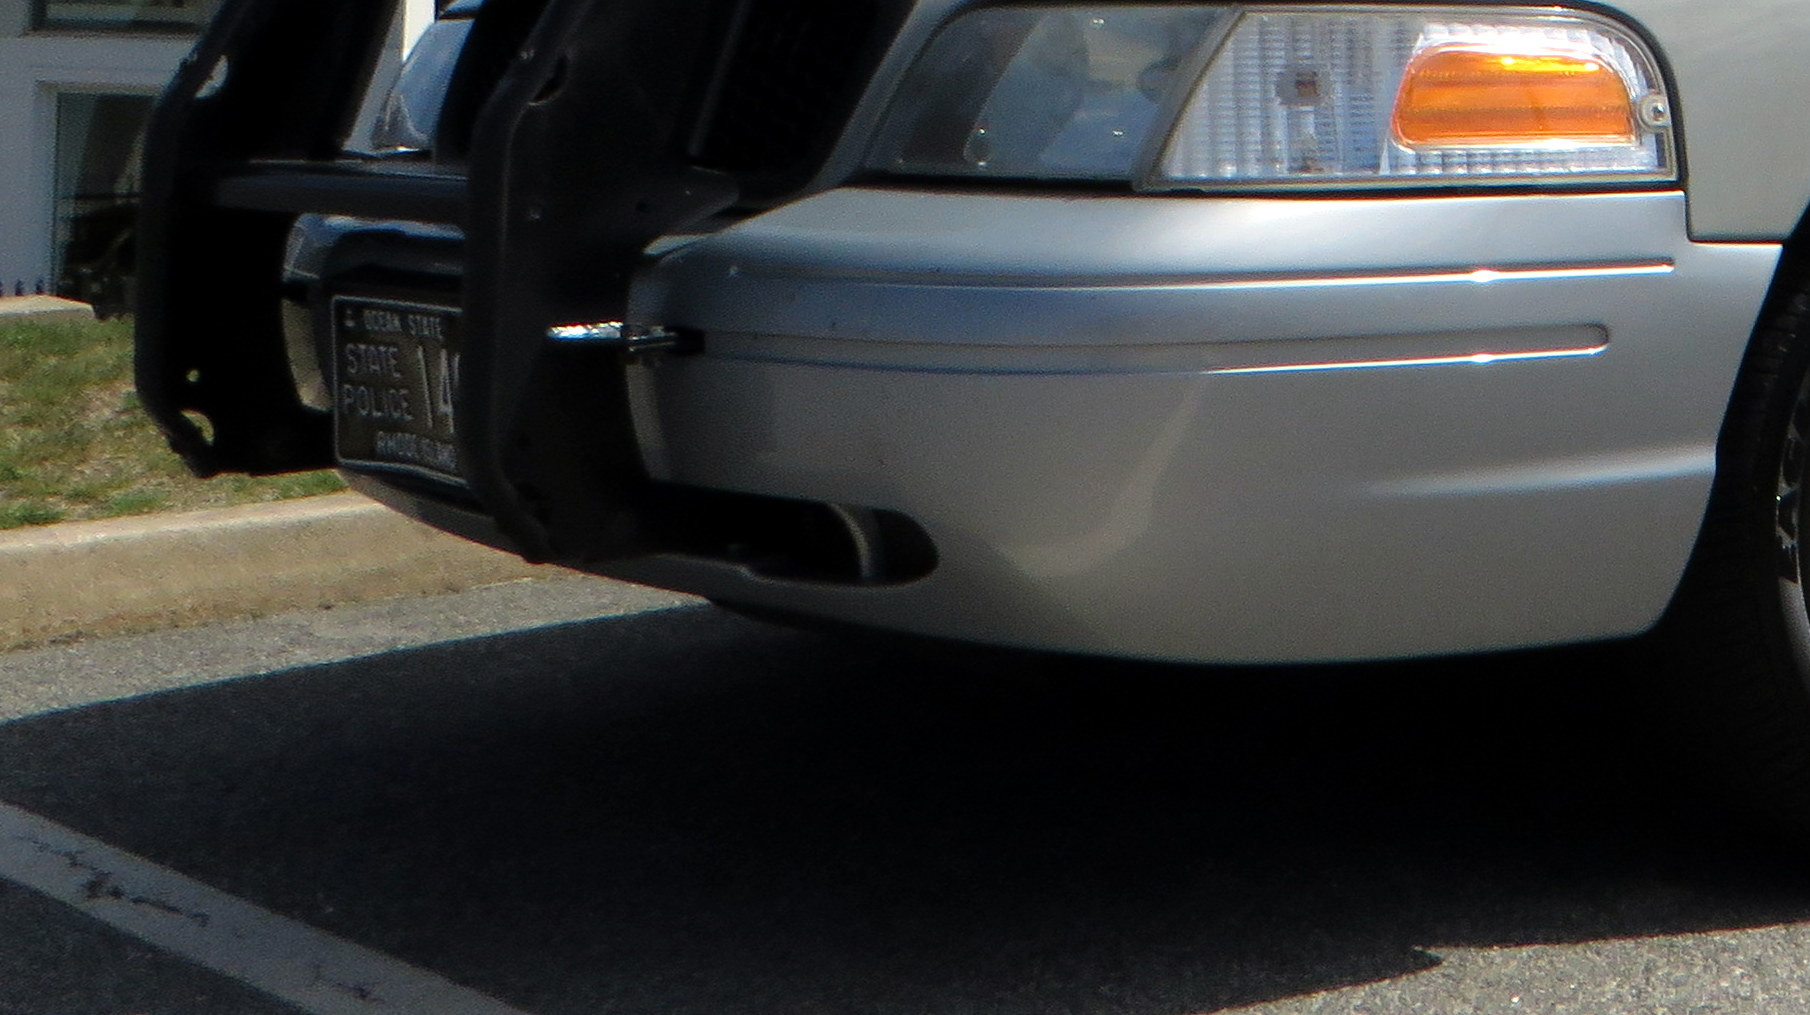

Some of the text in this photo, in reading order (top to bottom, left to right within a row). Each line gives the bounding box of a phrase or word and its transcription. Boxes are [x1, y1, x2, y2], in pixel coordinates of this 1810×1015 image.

[407, 313, 445, 340] STATE
[345, 342, 401, 379] STATE
[342, 383, 415, 422] POLICE
[416, 344, 462, 435] 14
